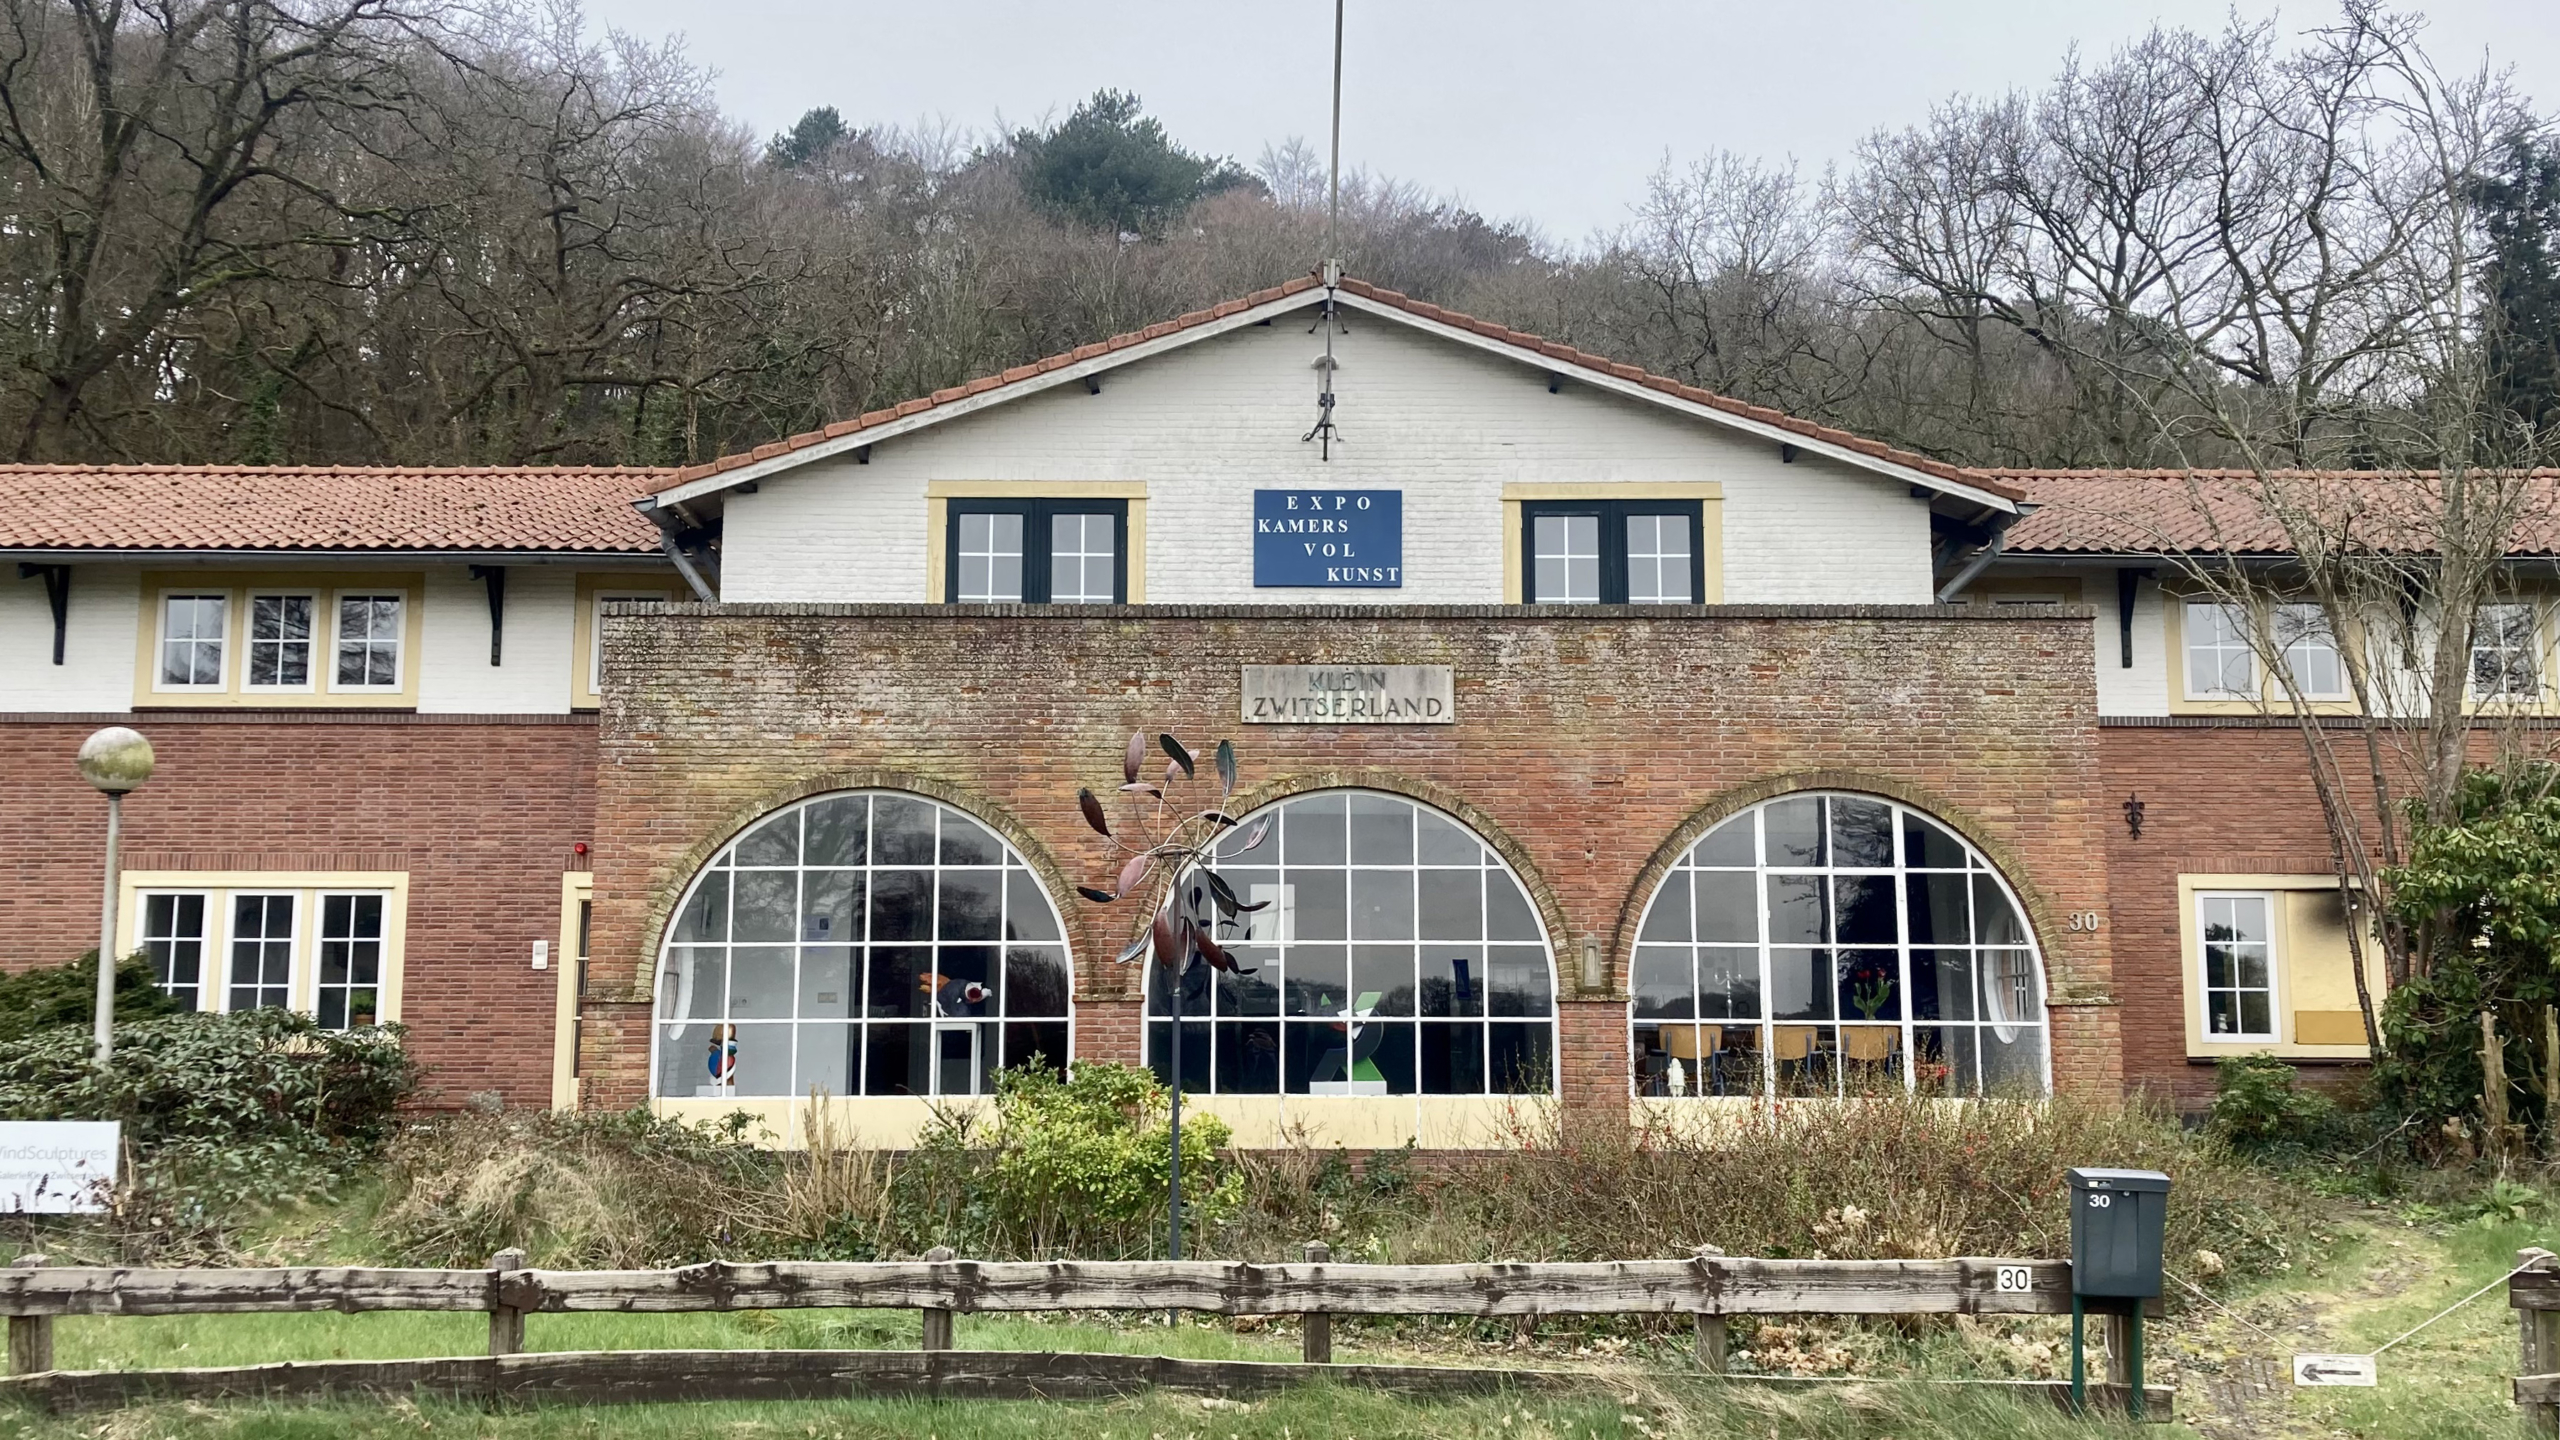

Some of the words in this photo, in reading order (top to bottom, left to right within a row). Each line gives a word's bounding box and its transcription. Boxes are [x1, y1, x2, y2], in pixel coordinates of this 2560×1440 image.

[1286, 496, 1371, 510] EXPO
[1258, 519, 1349, 533] KAMERS
[1303, 543, 1355, 557] VOL
[1326, 567, 1399, 582] KUNST
[1308, 672, 1387, 691] KLEIN
[1253, 697, 1443, 717] ZWITSERLAND
[2068, 912, 2099, 931] 30
[2089, 1194, 2111, 1208] 30
[2000, 1269, 2028, 1290] 30
